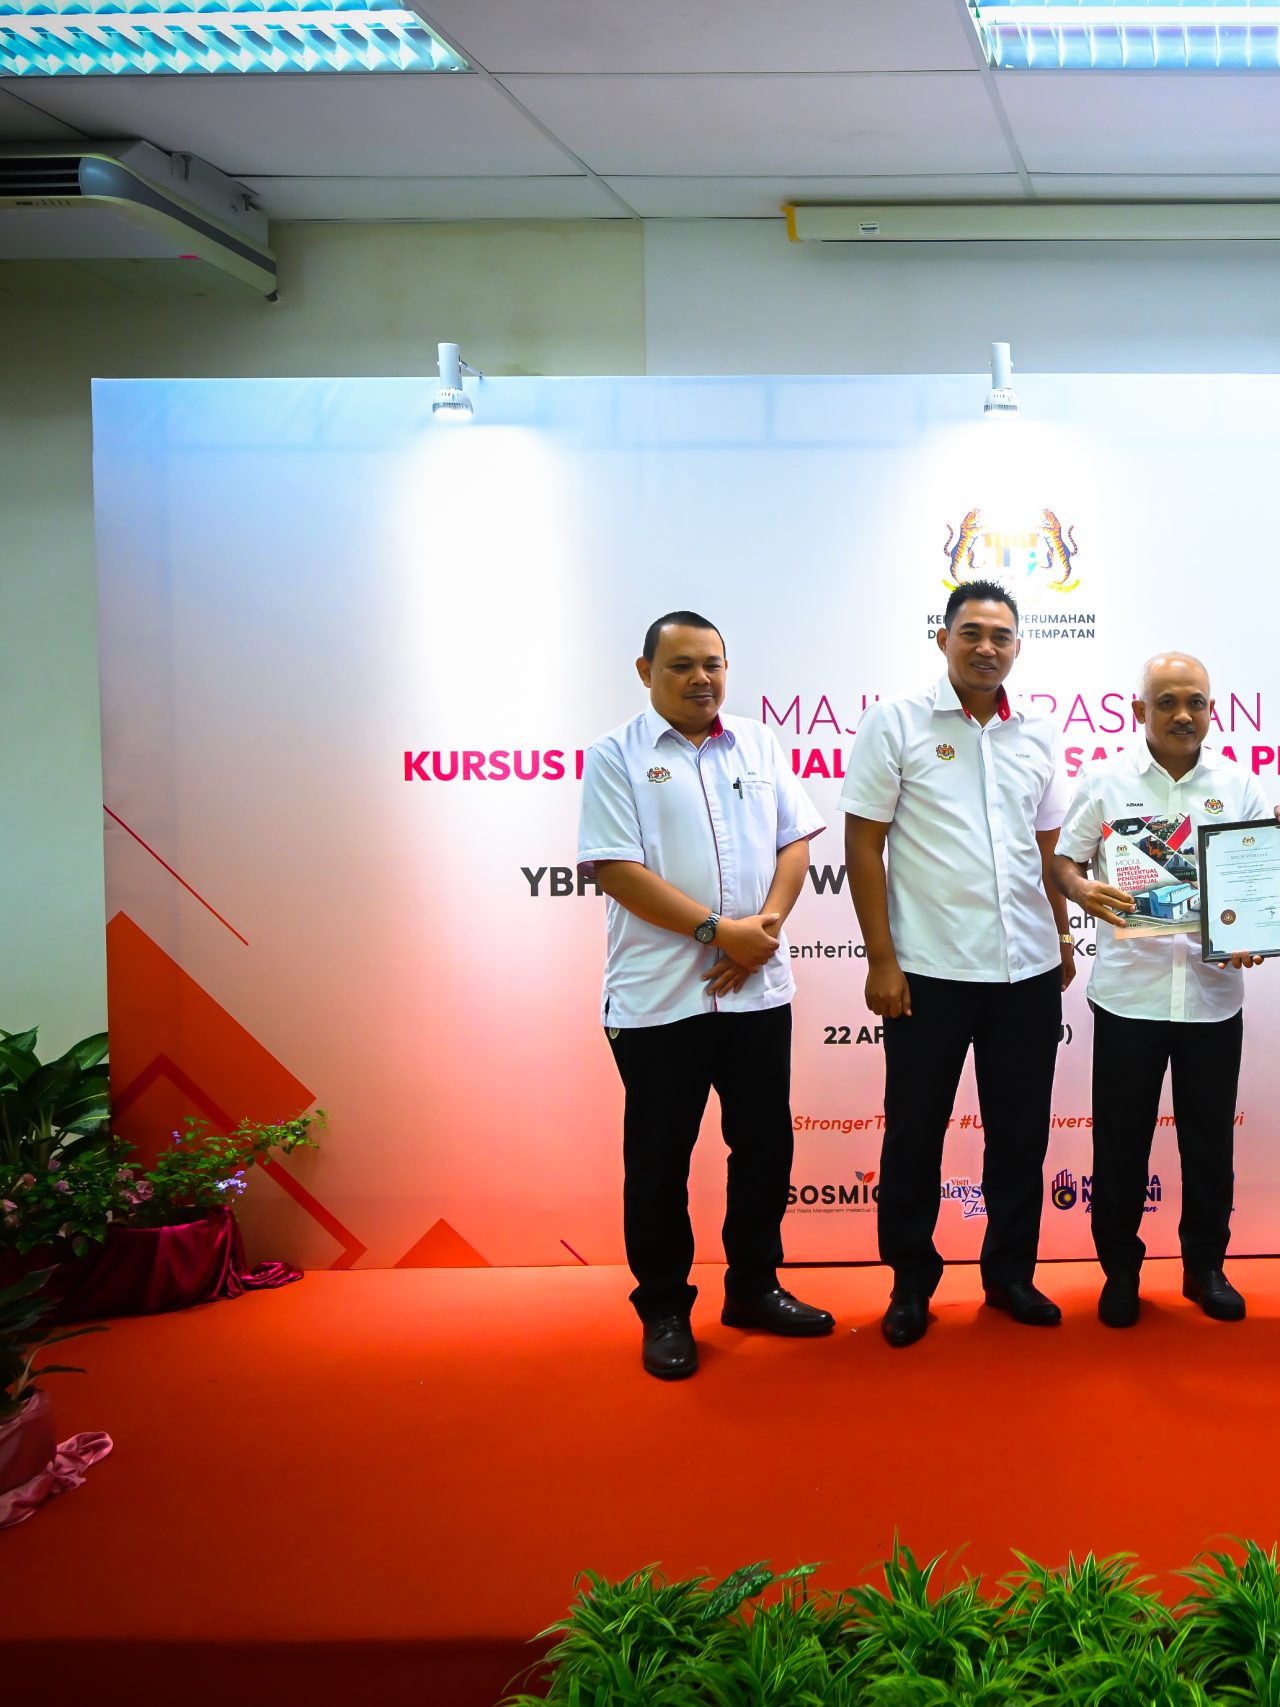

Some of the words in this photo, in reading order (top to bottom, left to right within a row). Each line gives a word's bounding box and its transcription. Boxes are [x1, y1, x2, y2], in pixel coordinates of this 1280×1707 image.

[1018, 614, 1095, 624] PERUMAHAN
[1028, 629, 1095, 638] TEMPATAN
[404, 750, 565, 781] KURSUS
[790, 940, 867, 958] enteria
[823, 1025, 852, 1044] 22
[940, 1183, 982, 1202] alays
